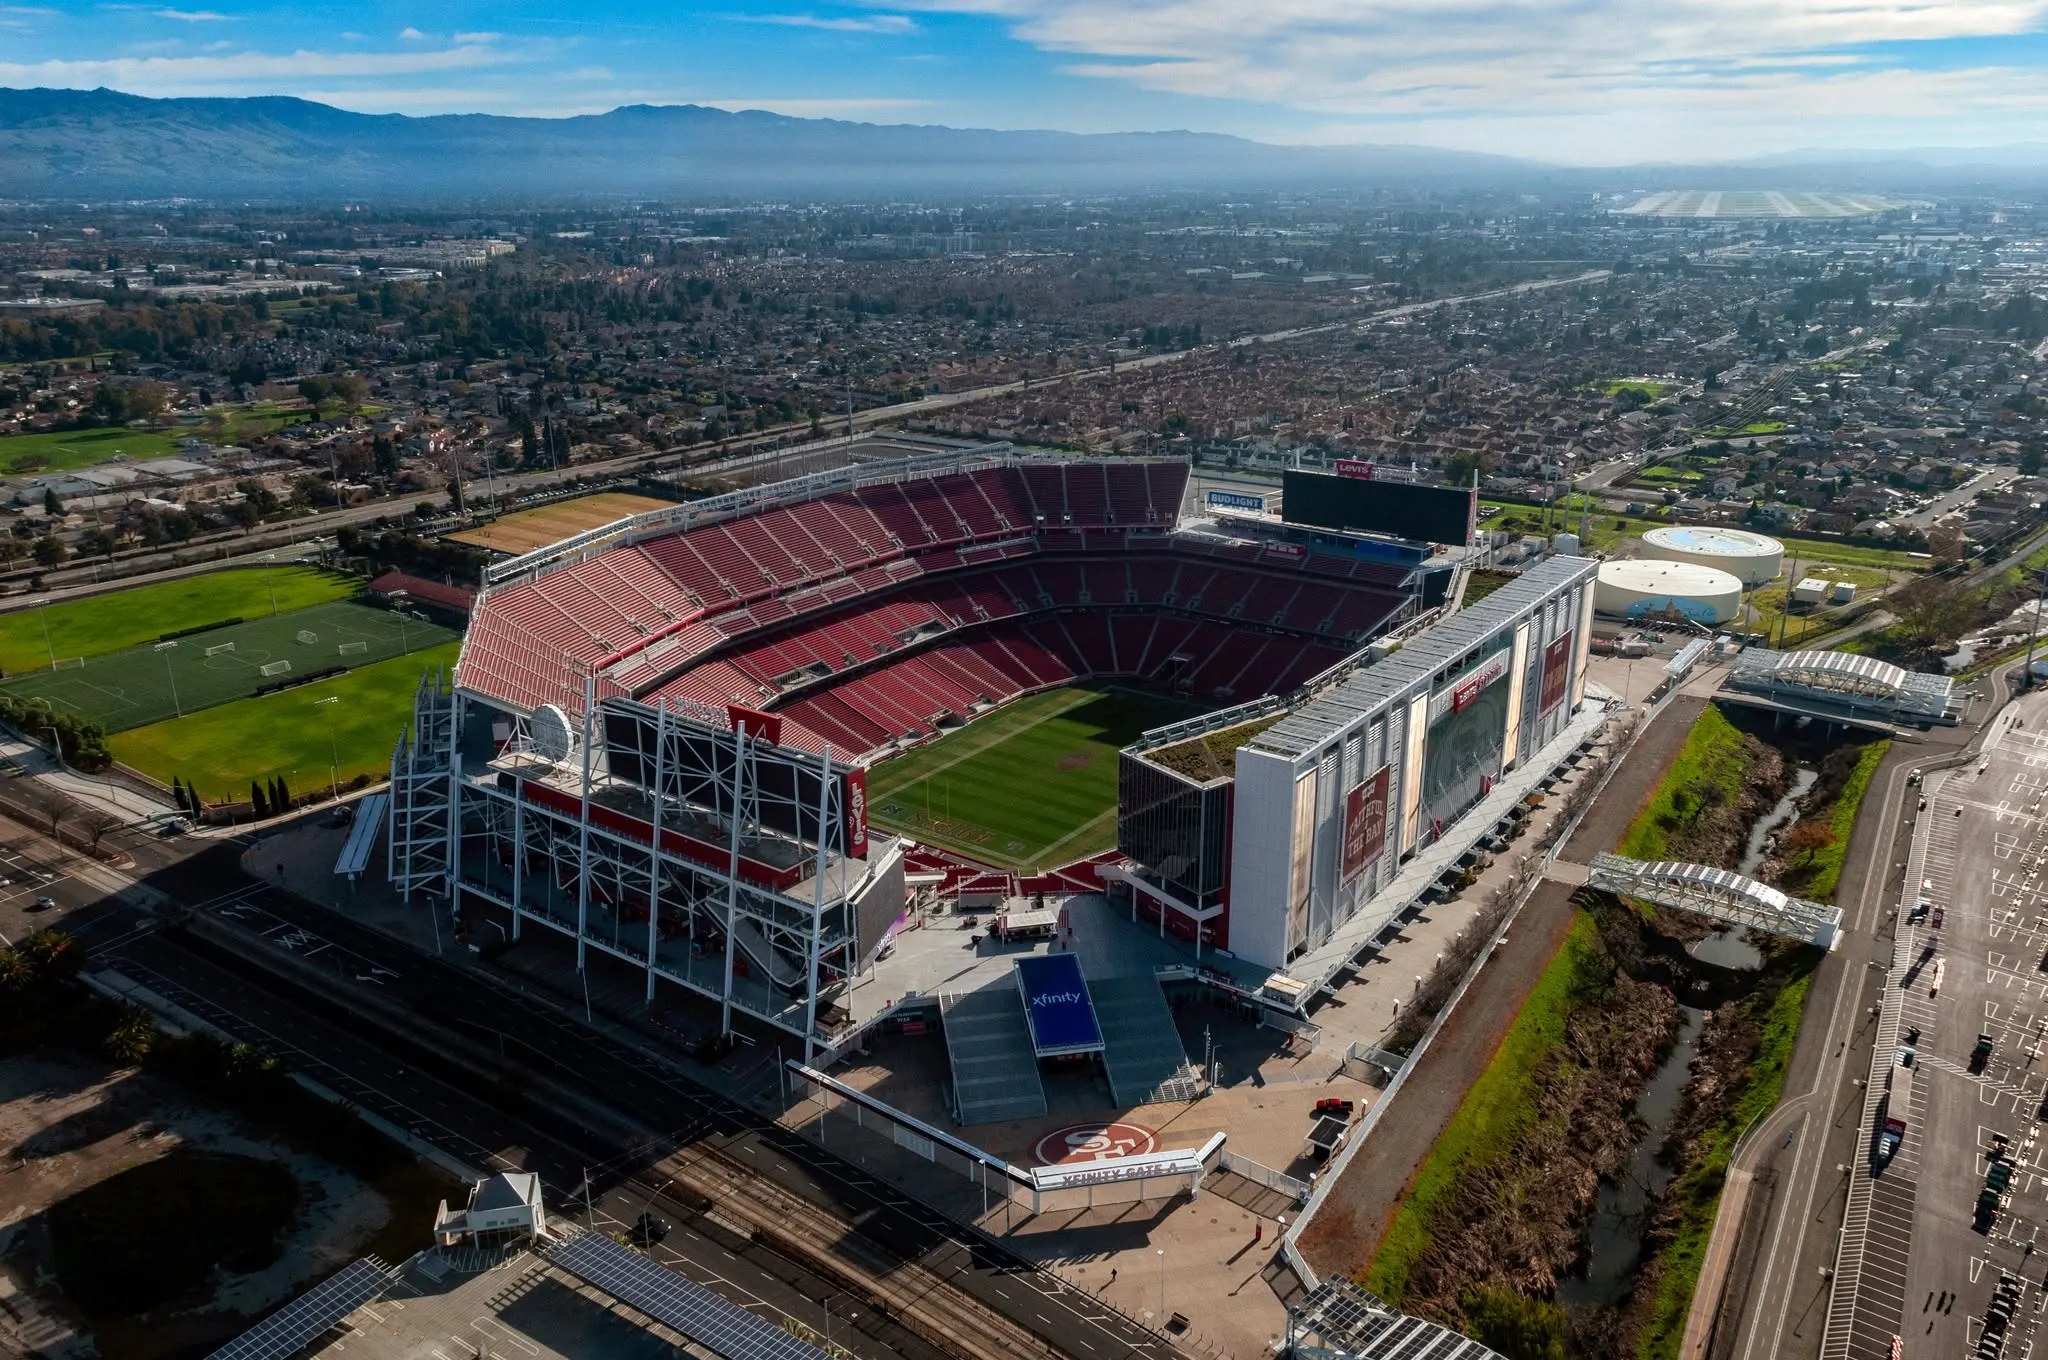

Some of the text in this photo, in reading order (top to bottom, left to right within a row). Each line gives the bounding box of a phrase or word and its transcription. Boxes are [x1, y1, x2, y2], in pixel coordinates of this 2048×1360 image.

[1211, 493, 1259, 508] BUD LIGHT
[1348, 799, 1384, 843] FAITHFUL
[1347, 832, 1365, 858] THE
[1365, 817, 1384, 846] BAY
[1032, 991, 1081, 1008] xfinity
[1062, 1162, 1178, 1186] XFINITY GATE A
